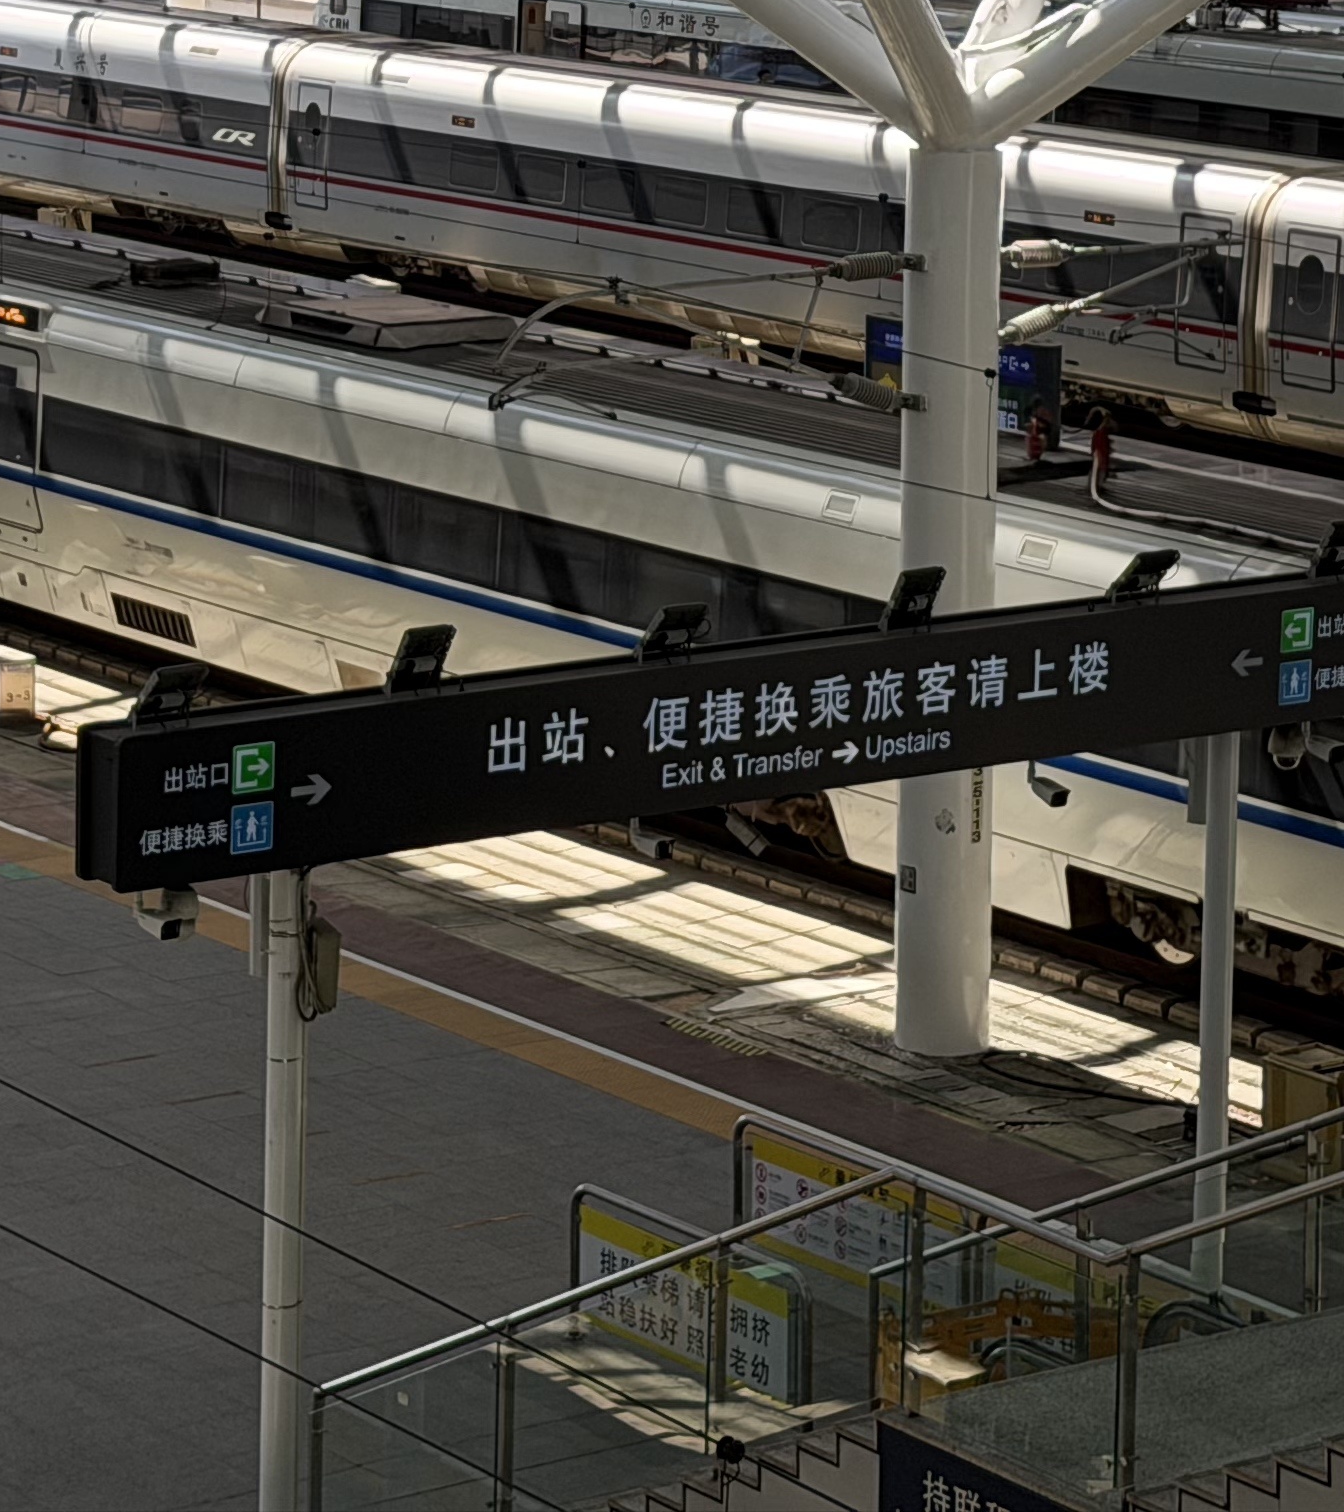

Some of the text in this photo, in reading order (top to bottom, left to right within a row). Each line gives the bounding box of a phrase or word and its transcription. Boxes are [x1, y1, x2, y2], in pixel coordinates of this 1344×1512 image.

[329, 17, 350, 30] CRH
[657, 11, 720, 37] 和谐号
[212, 128, 256, 147] CR
[487, 641, 1111, 775] 出站、便捷换乘旅客请上楼
[661, 728, 952, 790] Exit & Transfer Upstairs
[163, 760, 230, 795] 出站口
[139, 818, 229, 857] 便捷换乘
